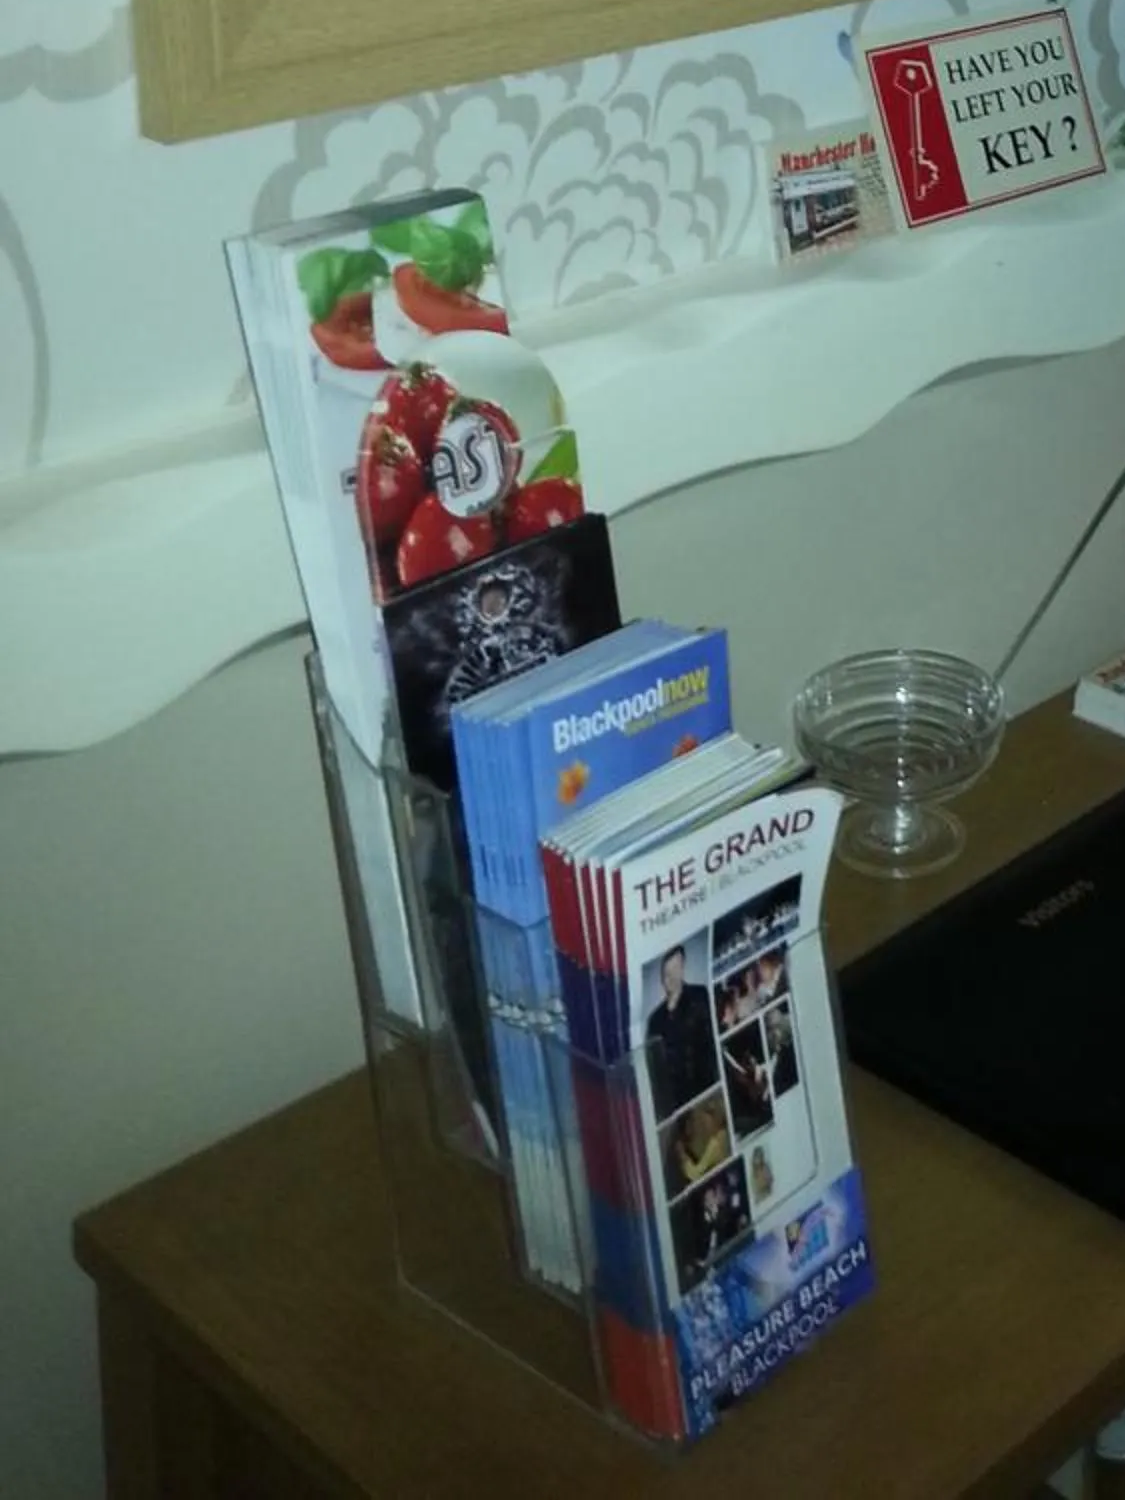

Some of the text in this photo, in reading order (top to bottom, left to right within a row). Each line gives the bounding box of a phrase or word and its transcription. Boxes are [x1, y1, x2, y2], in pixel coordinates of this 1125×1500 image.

[943, 36, 1066, 85] HAVE YOU
[951, 73, 1079, 123] LEFT YOUR
[634, 808, 815, 911] THE GRAND
[640, 886, 707, 934] THEATRE
[690, 1239, 867, 1400] PLEASURE BEACH
[731, 1297, 841, 1397] BLACKPOOL
